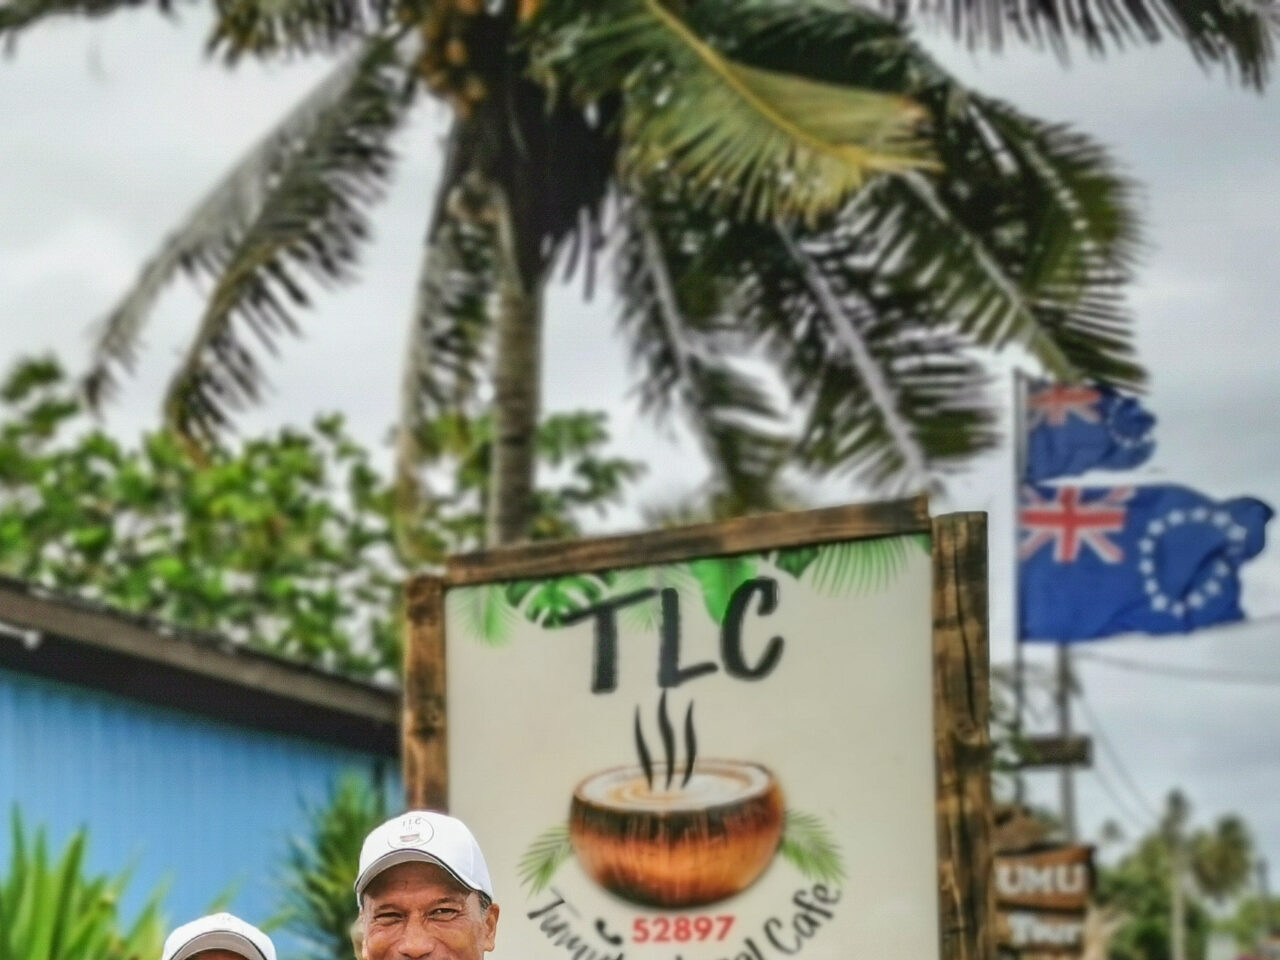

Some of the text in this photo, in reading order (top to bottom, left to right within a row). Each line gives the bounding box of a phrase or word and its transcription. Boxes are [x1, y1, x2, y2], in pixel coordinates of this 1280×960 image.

[541, 575, 784, 694] TLC
[631, 915, 736, 944] 52897
[763, 882, 842, 957] Cafe
